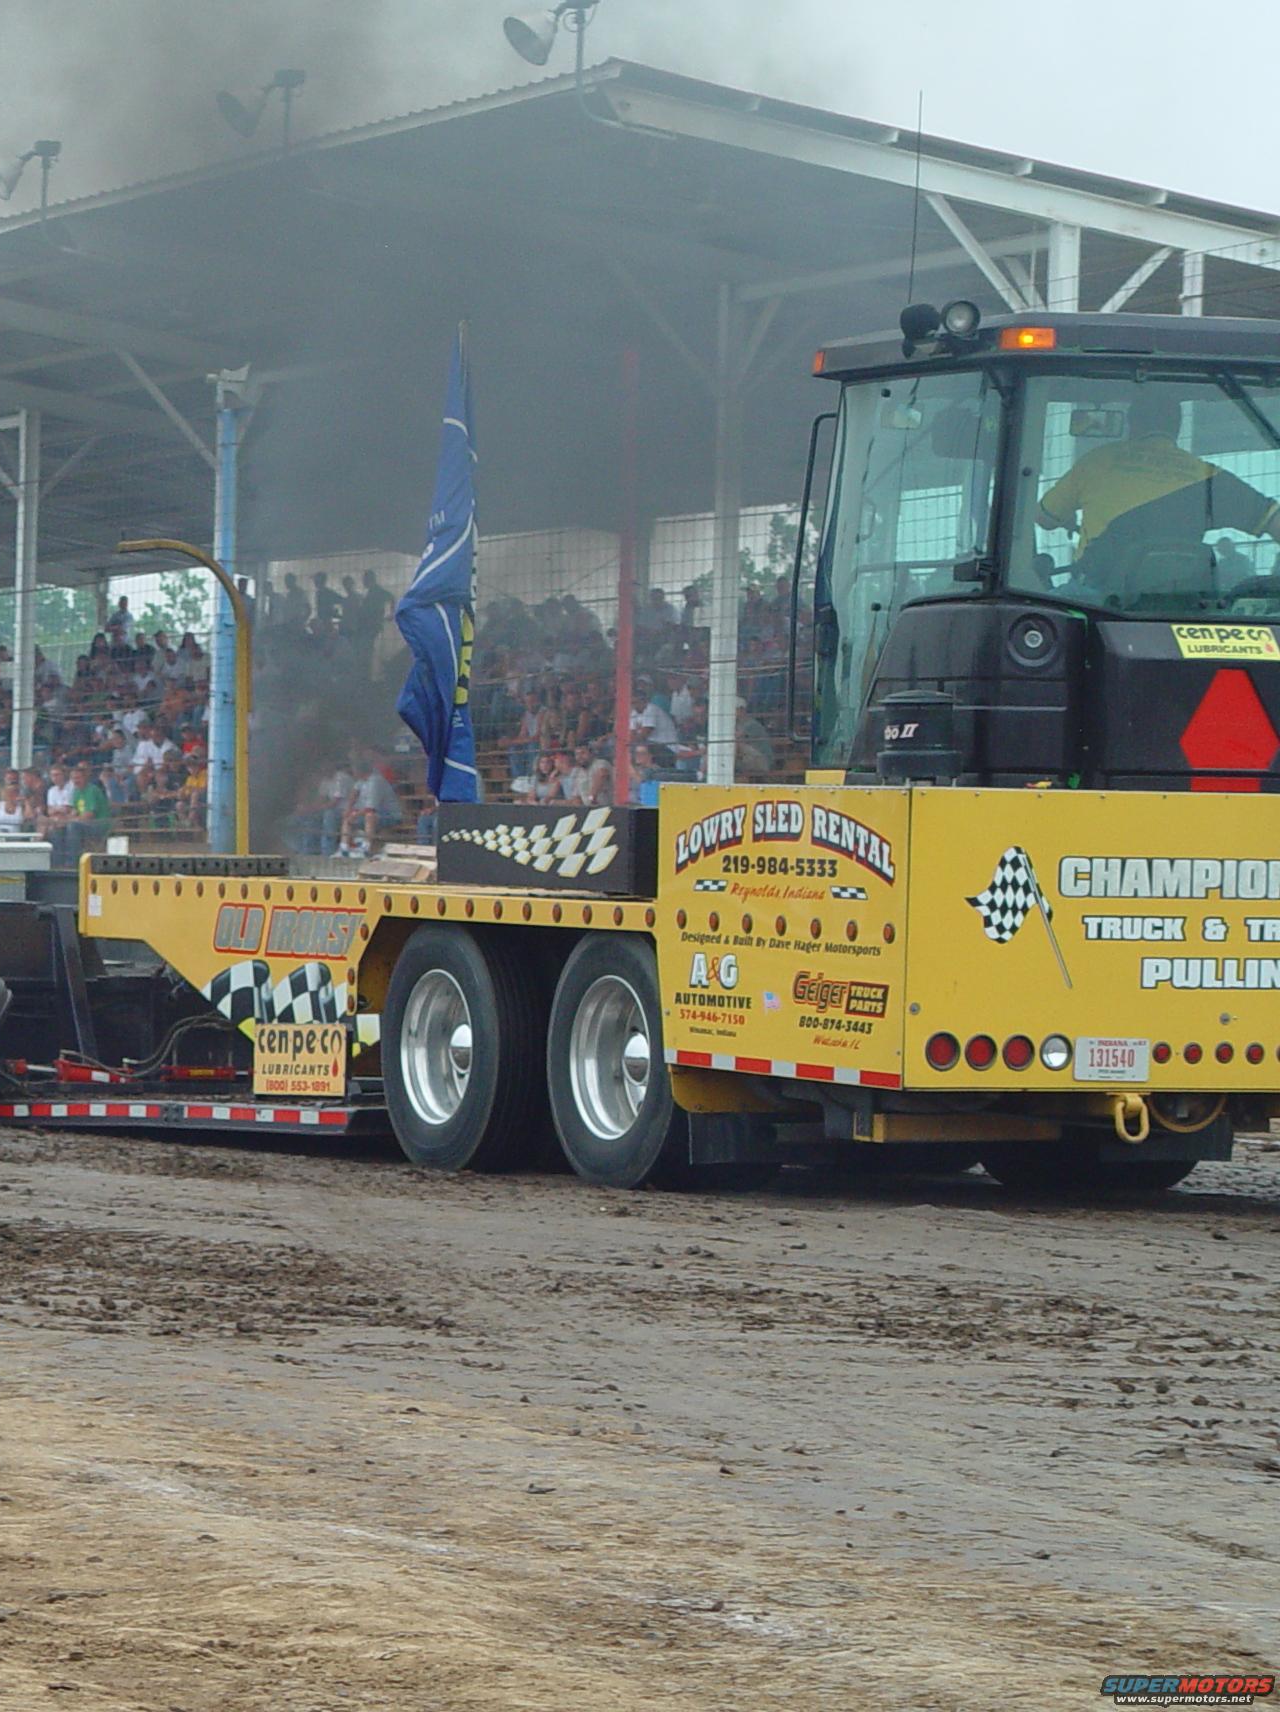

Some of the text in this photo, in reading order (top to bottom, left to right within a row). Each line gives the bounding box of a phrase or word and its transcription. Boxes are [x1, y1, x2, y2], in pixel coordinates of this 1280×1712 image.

[1187, 645, 1263, 655] LUBRICANTS
[676, 800, 896, 887] LOWRY SLED RENTAL
[722, 855, 837, 877] 219-984-5333
[783, 885, 826, 900] Indiana
[213, 902, 266, 955] OLD
[1082, 915, 1187, 942] TRUCK
[1202, 916, 1230, 942] &
[681, 931, 882, 957] Designed & Built By Dave Hager Motorsports
[674, 992, 752, 1010] AUTOMOTIVE
[793, 971, 848, 1013] Geiger
[851, 986, 885, 999] TRUCK
[849, 1000, 883, 1014] PARTS
[680, 1009, 745, 1025] 574-946-7150
[799, 1016, 873, 1035] 800-874-3443
[1089, 1048, 1135, 1068] 131540
[262, 1063, 330, 1077] LUBRICANTS
[266, 1079, 288, 1092] (800)
